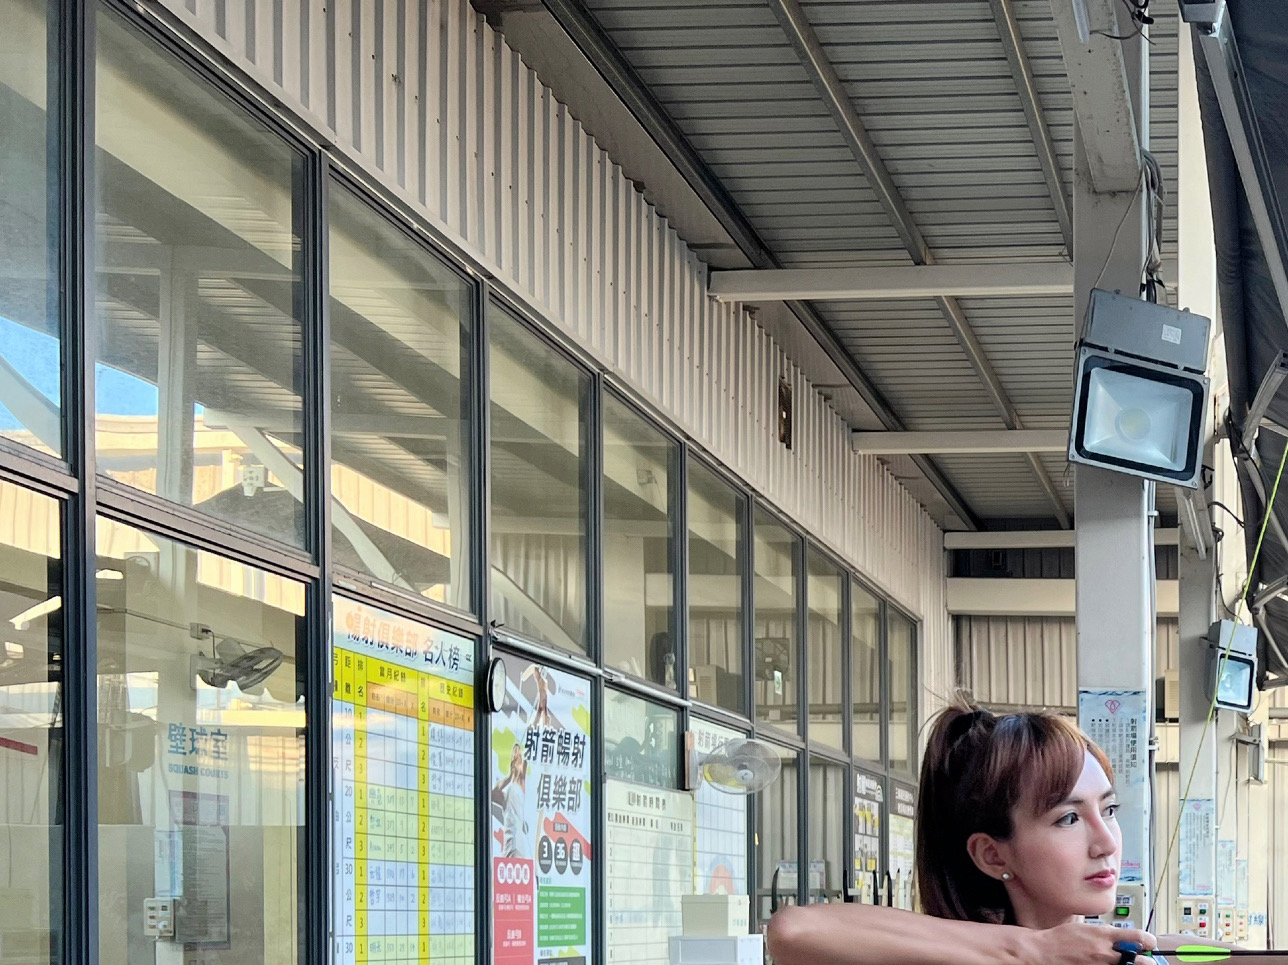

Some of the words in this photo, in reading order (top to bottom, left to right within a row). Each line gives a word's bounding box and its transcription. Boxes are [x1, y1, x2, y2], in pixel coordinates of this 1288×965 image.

[423, 637, 461, 672] 名人榜
[167, 723, 228, 761] 壁球室
[524, 726, 586, 769] 射箭暢射
[168, 763, 198, 776] SQUASH
[200, 768, 229, 779] COURTS
[537, 774, 583, 813] 俱樂部
[542, 841, 548, 858] 3
[556, 842, 565, 859] 36
